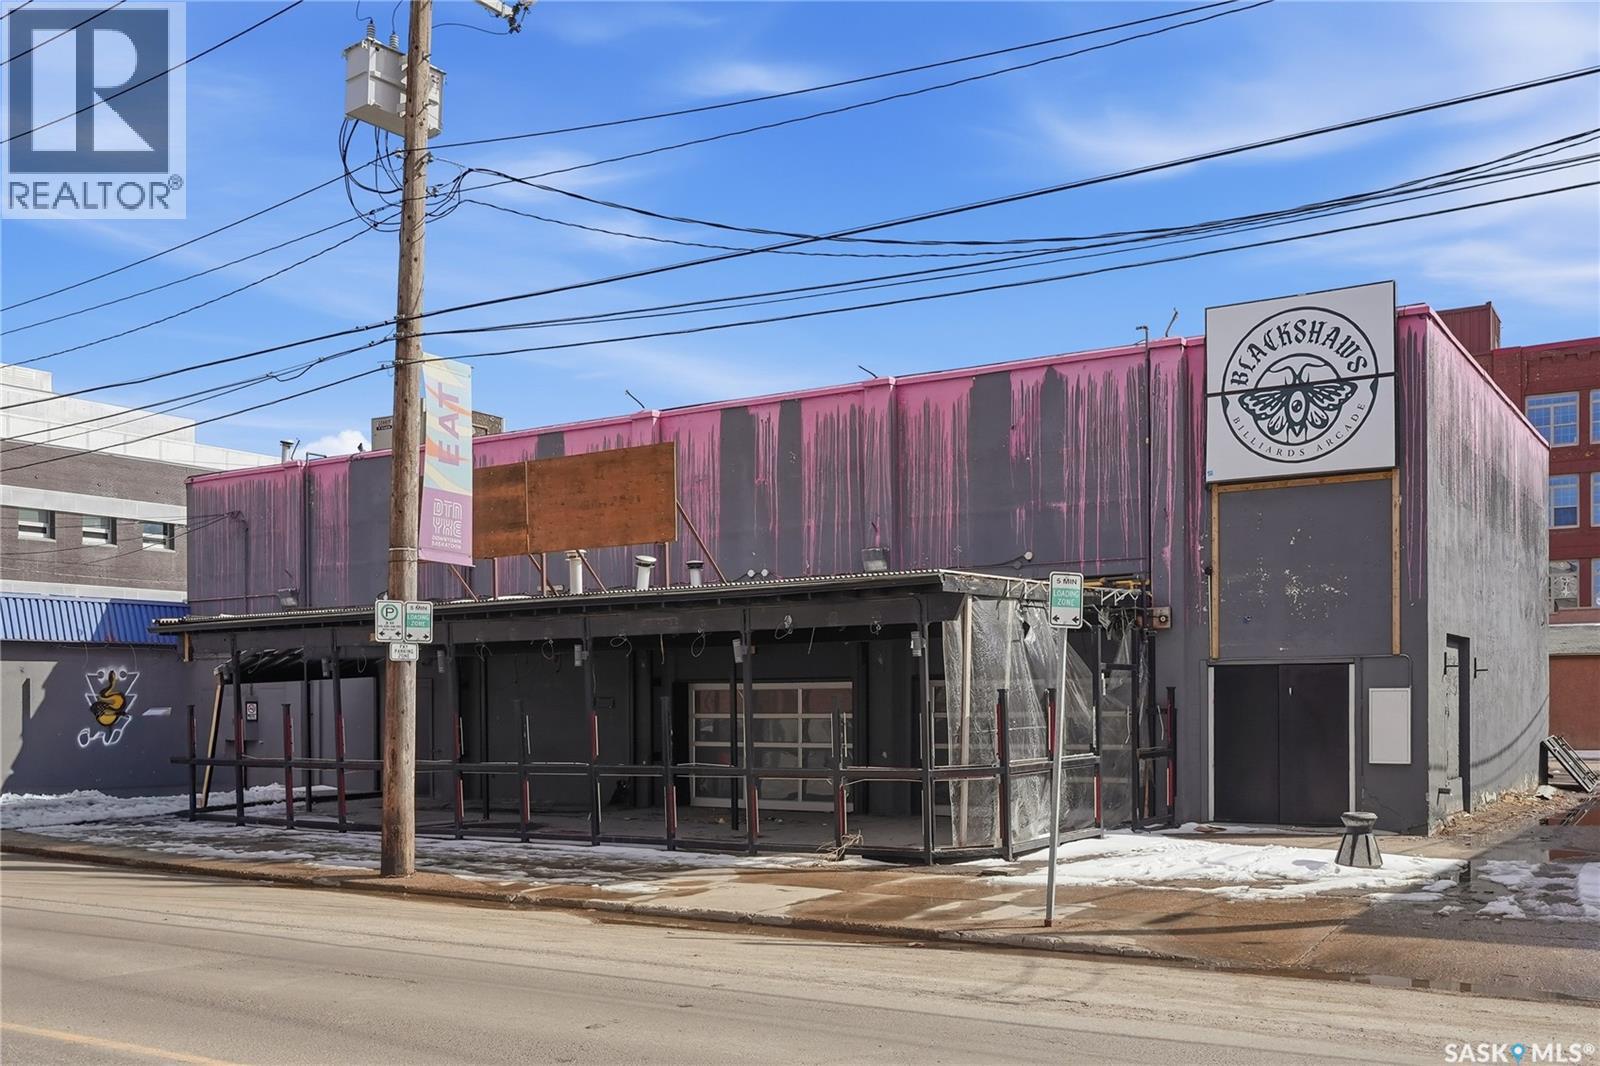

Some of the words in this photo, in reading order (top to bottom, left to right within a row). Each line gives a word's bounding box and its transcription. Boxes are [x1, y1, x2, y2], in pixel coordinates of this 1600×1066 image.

[1230, 318, 1368, 387] BLACKSHAWS
[438, 381, 460, 467] EAT
[1233, 415, 1306, 458] BILLIARDS
[1315, 402, 1366, 452] ARCADE
[1054, 590, 1080, 599] LOADING
[1057, 598, 1076, 606] ZONE
